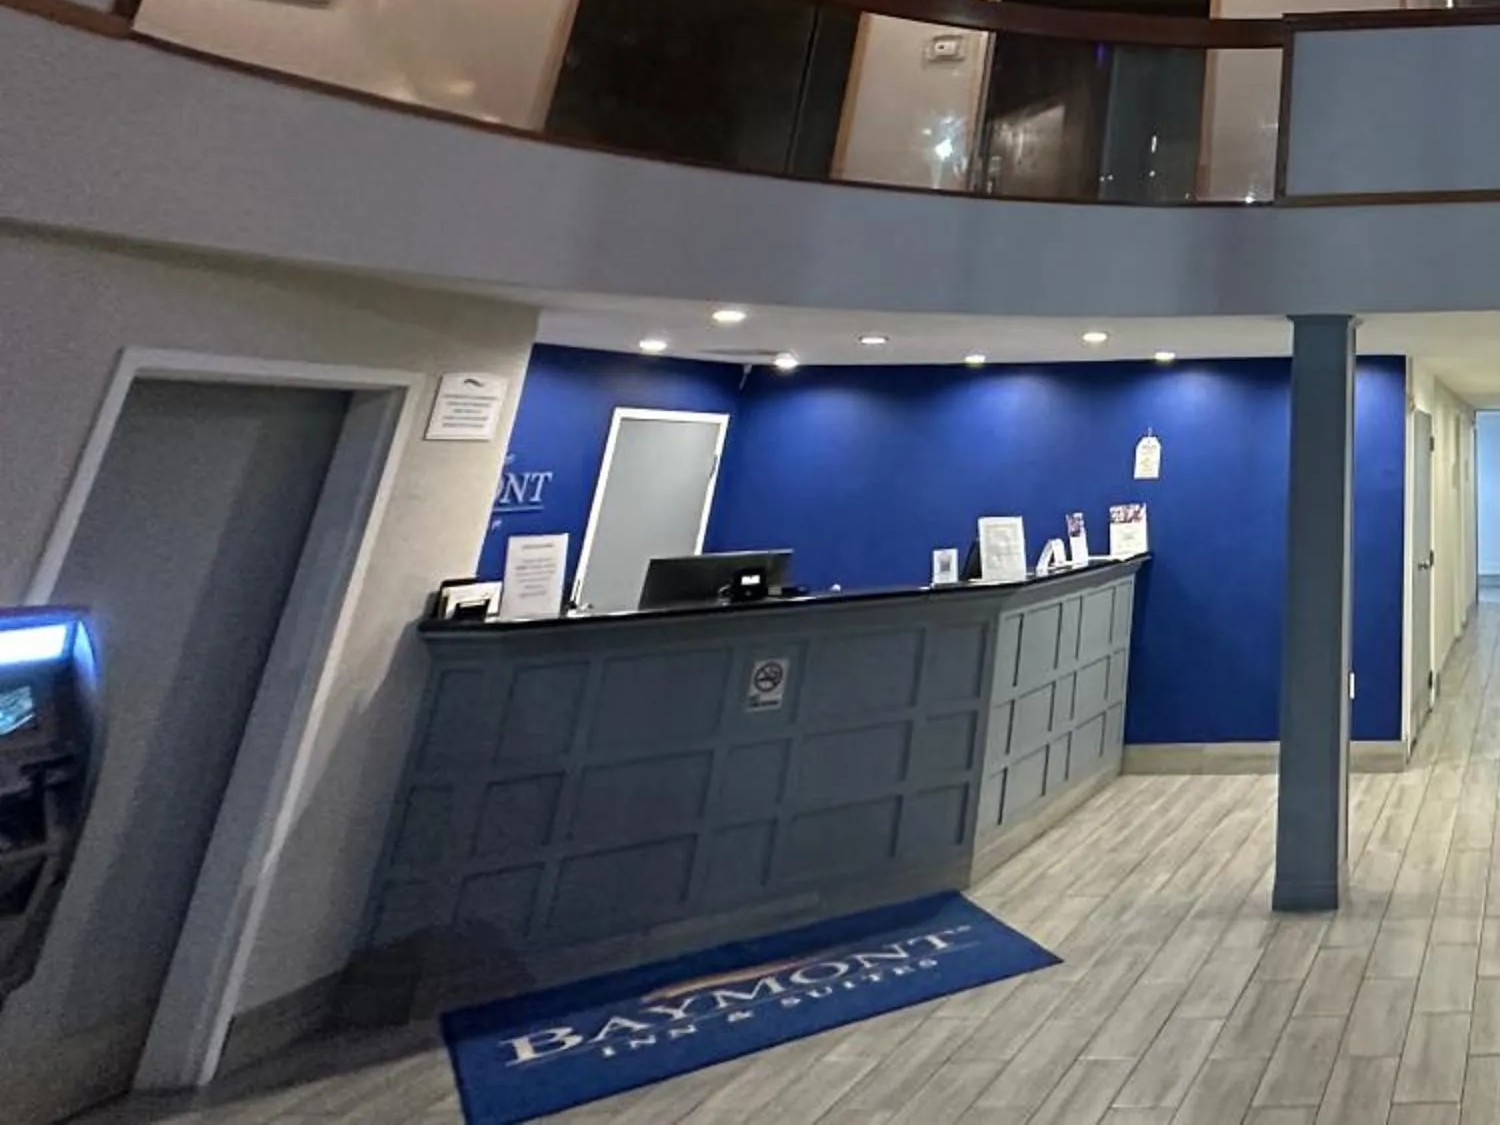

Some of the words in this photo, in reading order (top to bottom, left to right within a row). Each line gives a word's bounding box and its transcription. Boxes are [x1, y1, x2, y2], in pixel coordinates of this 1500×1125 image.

[496, 472, 553, 503] NT
[503, 930, 957, 1062] BAYMONT
[603, 1023, 697, 1058] INN
[781, 959, 938, 1007] SUITES
